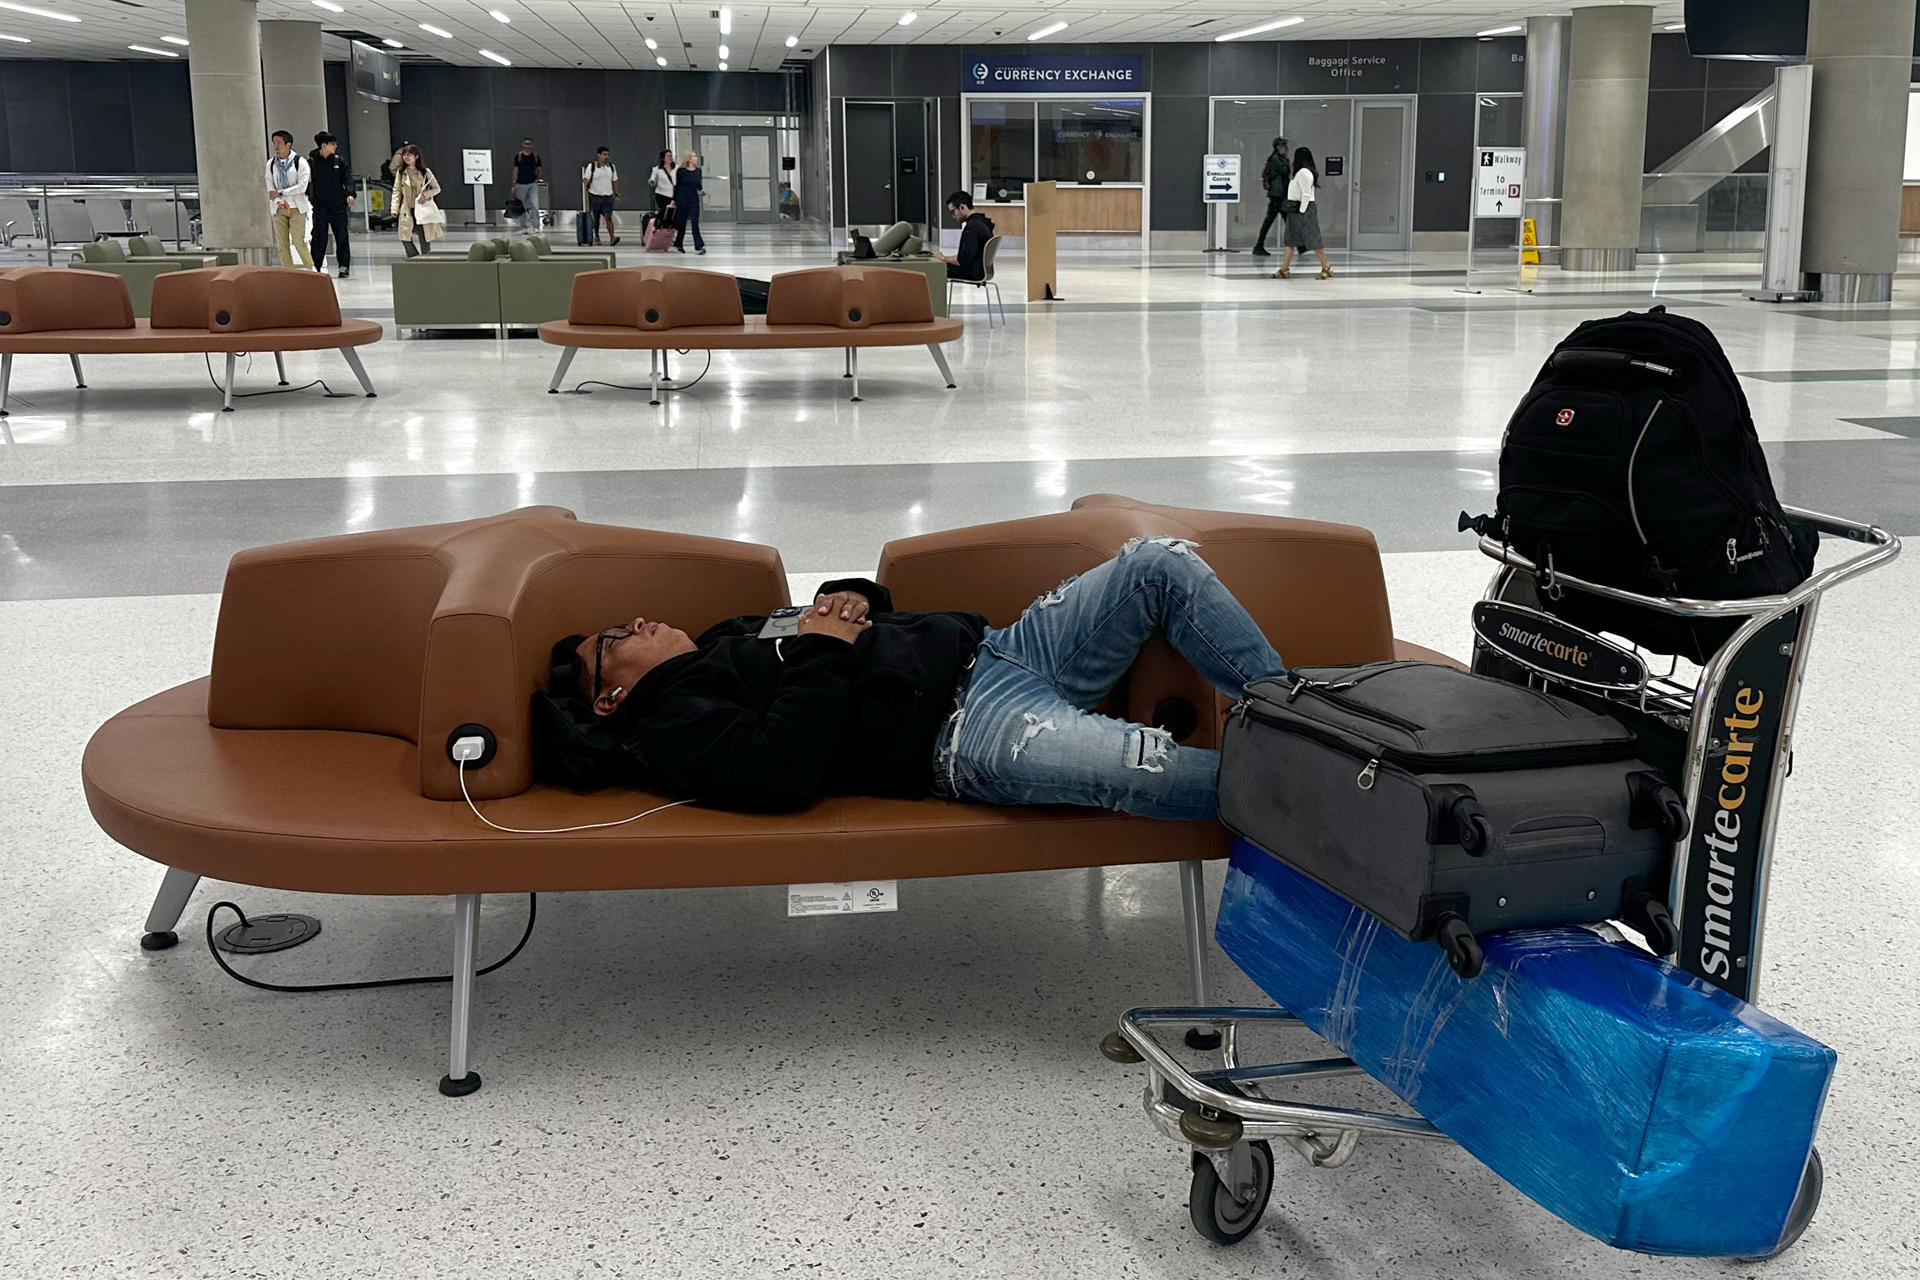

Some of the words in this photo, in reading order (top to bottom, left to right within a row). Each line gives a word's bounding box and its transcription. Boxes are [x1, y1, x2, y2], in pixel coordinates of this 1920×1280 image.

[1308, 57, 1349, 67] Baggage
[1352, 56, 1386, 65] Service
[995, 70, 1061, 80] CURRENCY
[1065, 70, 1132, 80] EXCHANGE
[1331, 68, 1363, 77] Office
[1495, 155, 1521, 166] Walkway
[1496, 175, 1505, 183] to
[1480, 187, 1507, 196] Terminal
[1510, 186, 1519, 196] D
